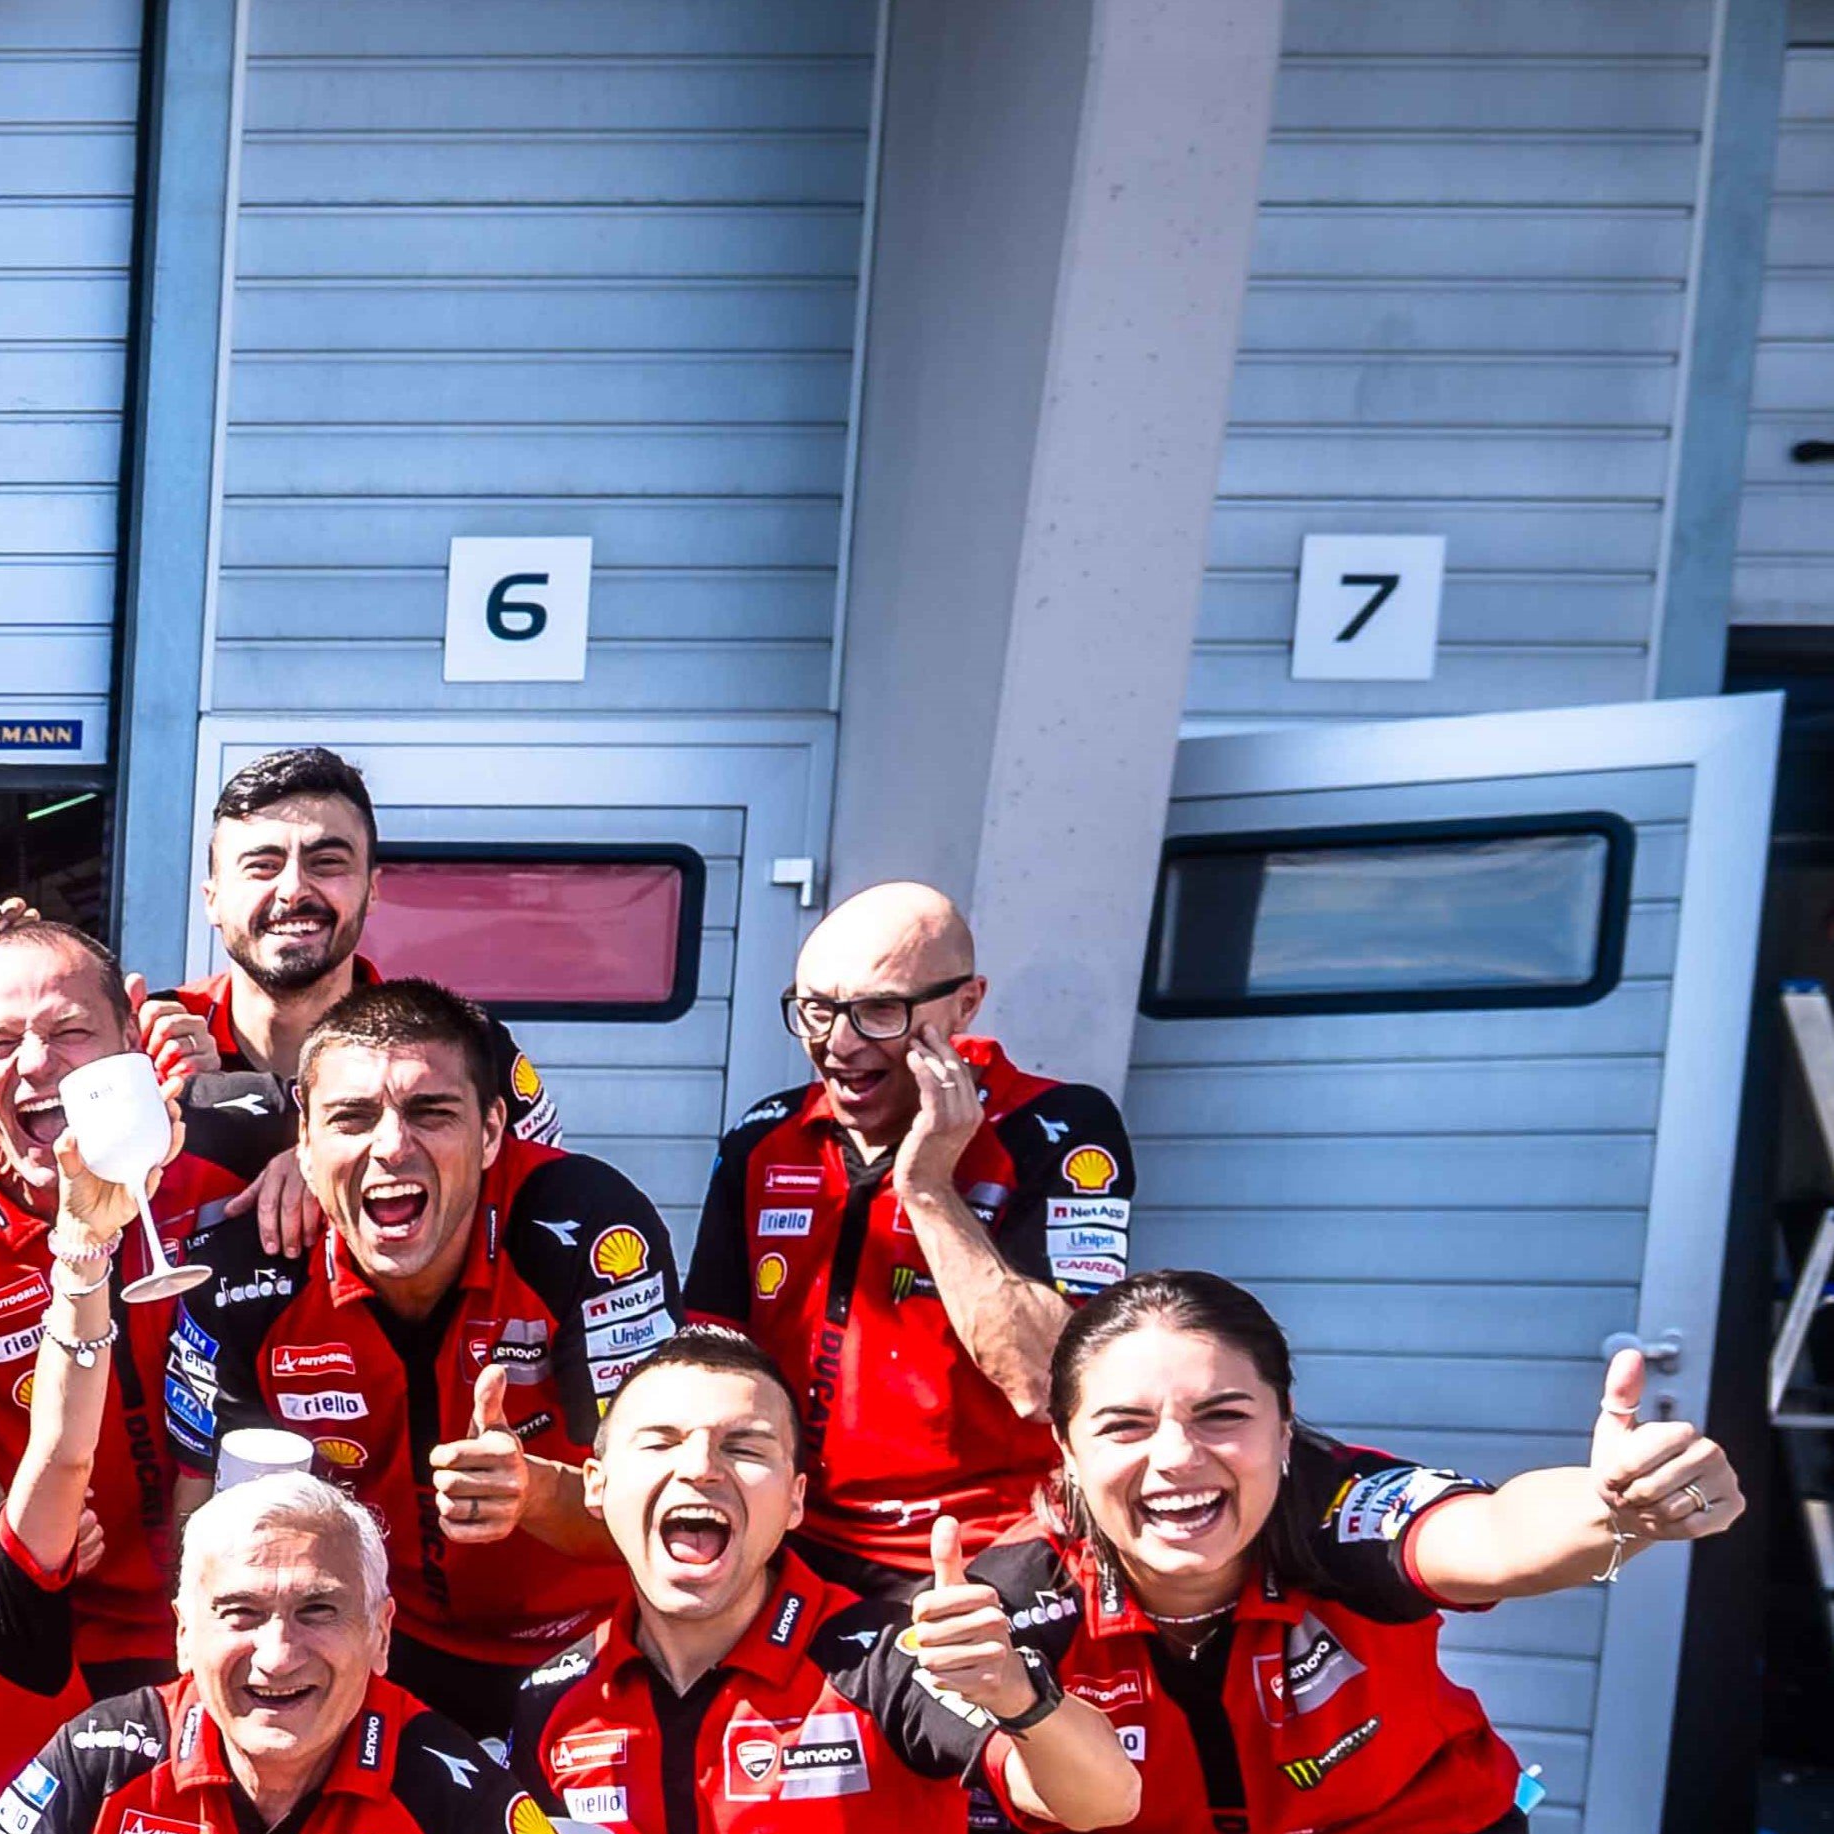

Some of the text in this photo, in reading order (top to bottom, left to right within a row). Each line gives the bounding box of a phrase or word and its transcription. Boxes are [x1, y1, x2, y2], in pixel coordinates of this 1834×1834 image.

[485, 573, 550, 641] 6
[1335, 574, 1400, 642] 7
[768, 1211, 806, 1230] riello
[1069, 1205, 1124, 1219] NetApp
[1071, 1232, 1115, 1247] Unipol
[214, 1269, 292, 1308] diadora
[611, 1284, 661, 1311] NetApp
[4, 1328, 48, 1355] riell
[184, 1318, 206, 1351] TIM
[612, 1321, 654, 1346] Unipol
[305, 1394, 358, 1415] riello
[772, 1597, 799, 1643] Lenovo
[1289, 1640, 1329, 1682] enovo
[362, 1717, 379, 1765] Lenovo
[1319, 1717, 1379, 1765] MONSTER
[784, 1748, 852, 1766] Lenovo
